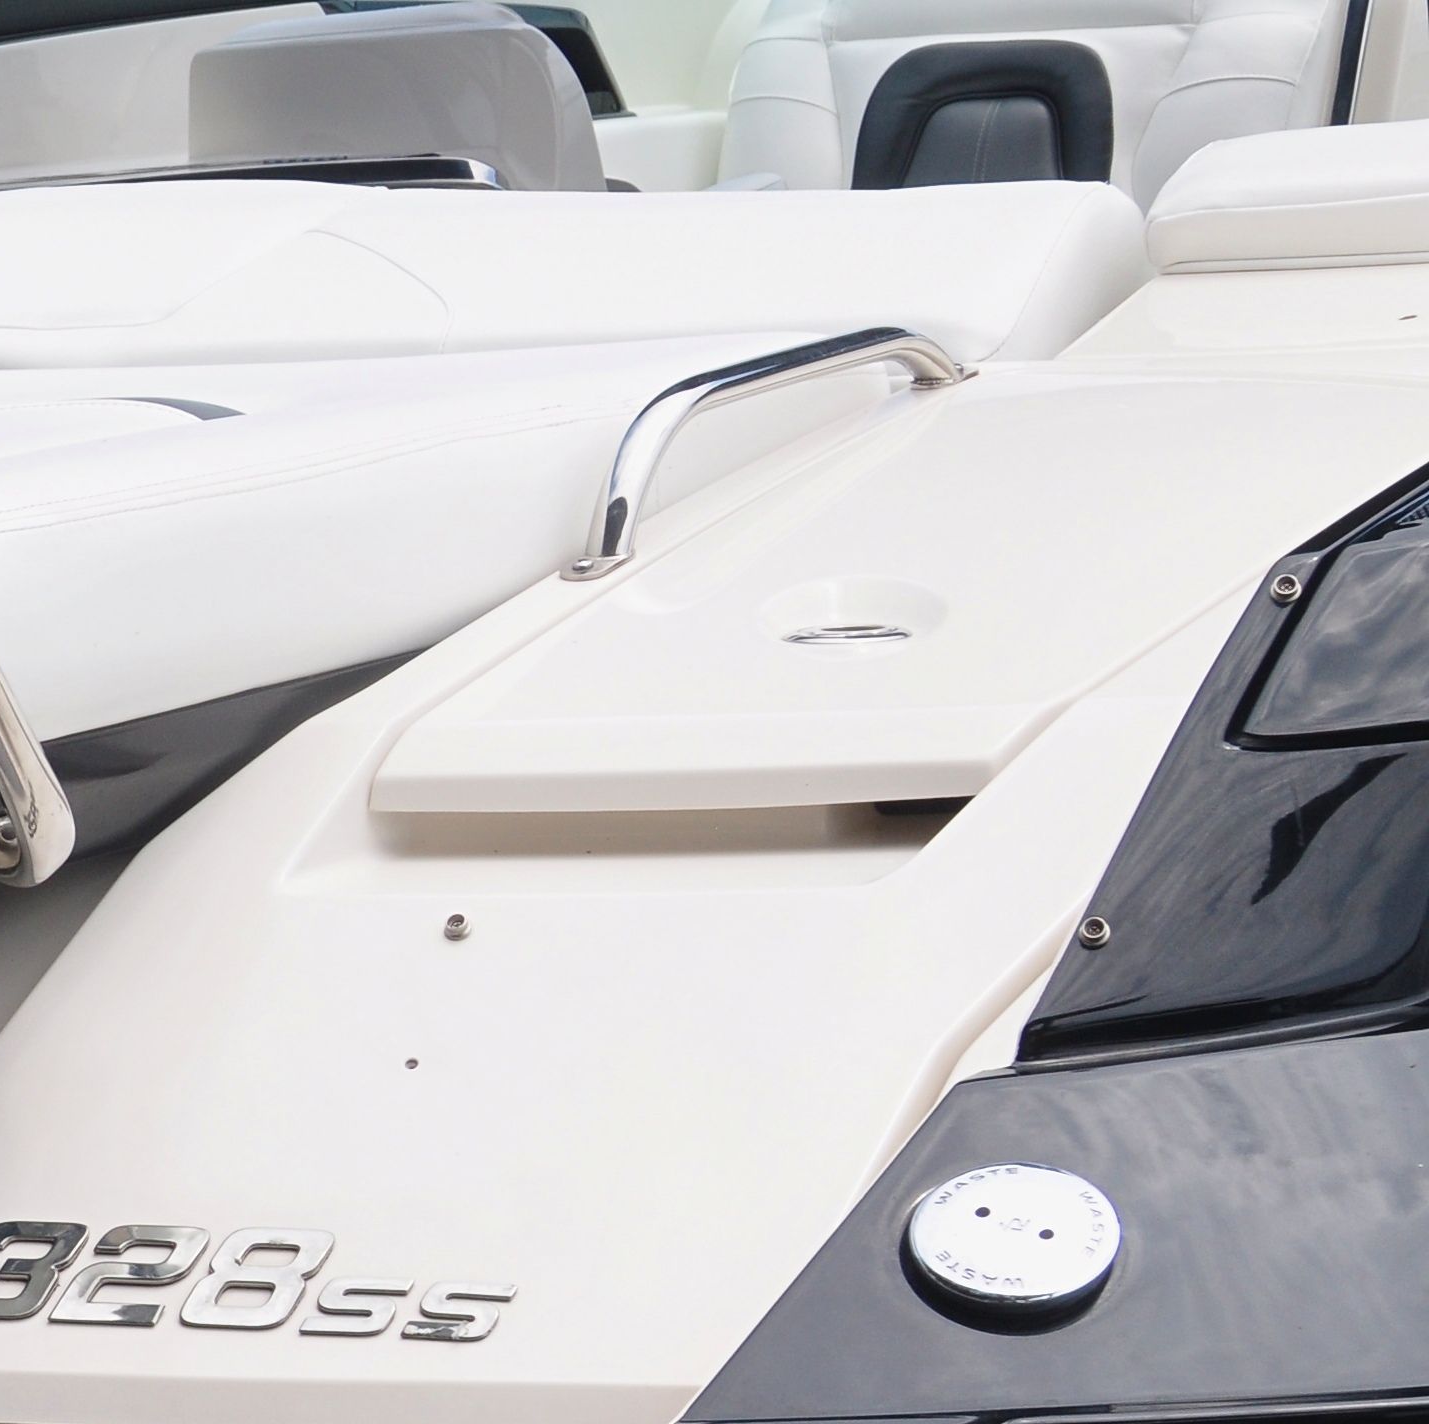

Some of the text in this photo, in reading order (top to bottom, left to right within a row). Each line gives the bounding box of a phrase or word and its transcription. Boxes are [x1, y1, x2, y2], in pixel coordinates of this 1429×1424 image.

[934, 1167, 1019, 1205] WASTE
[1079, 1191, 1106, 1259] WASTE
[935, 1250, 1025, 1288] WASTE
